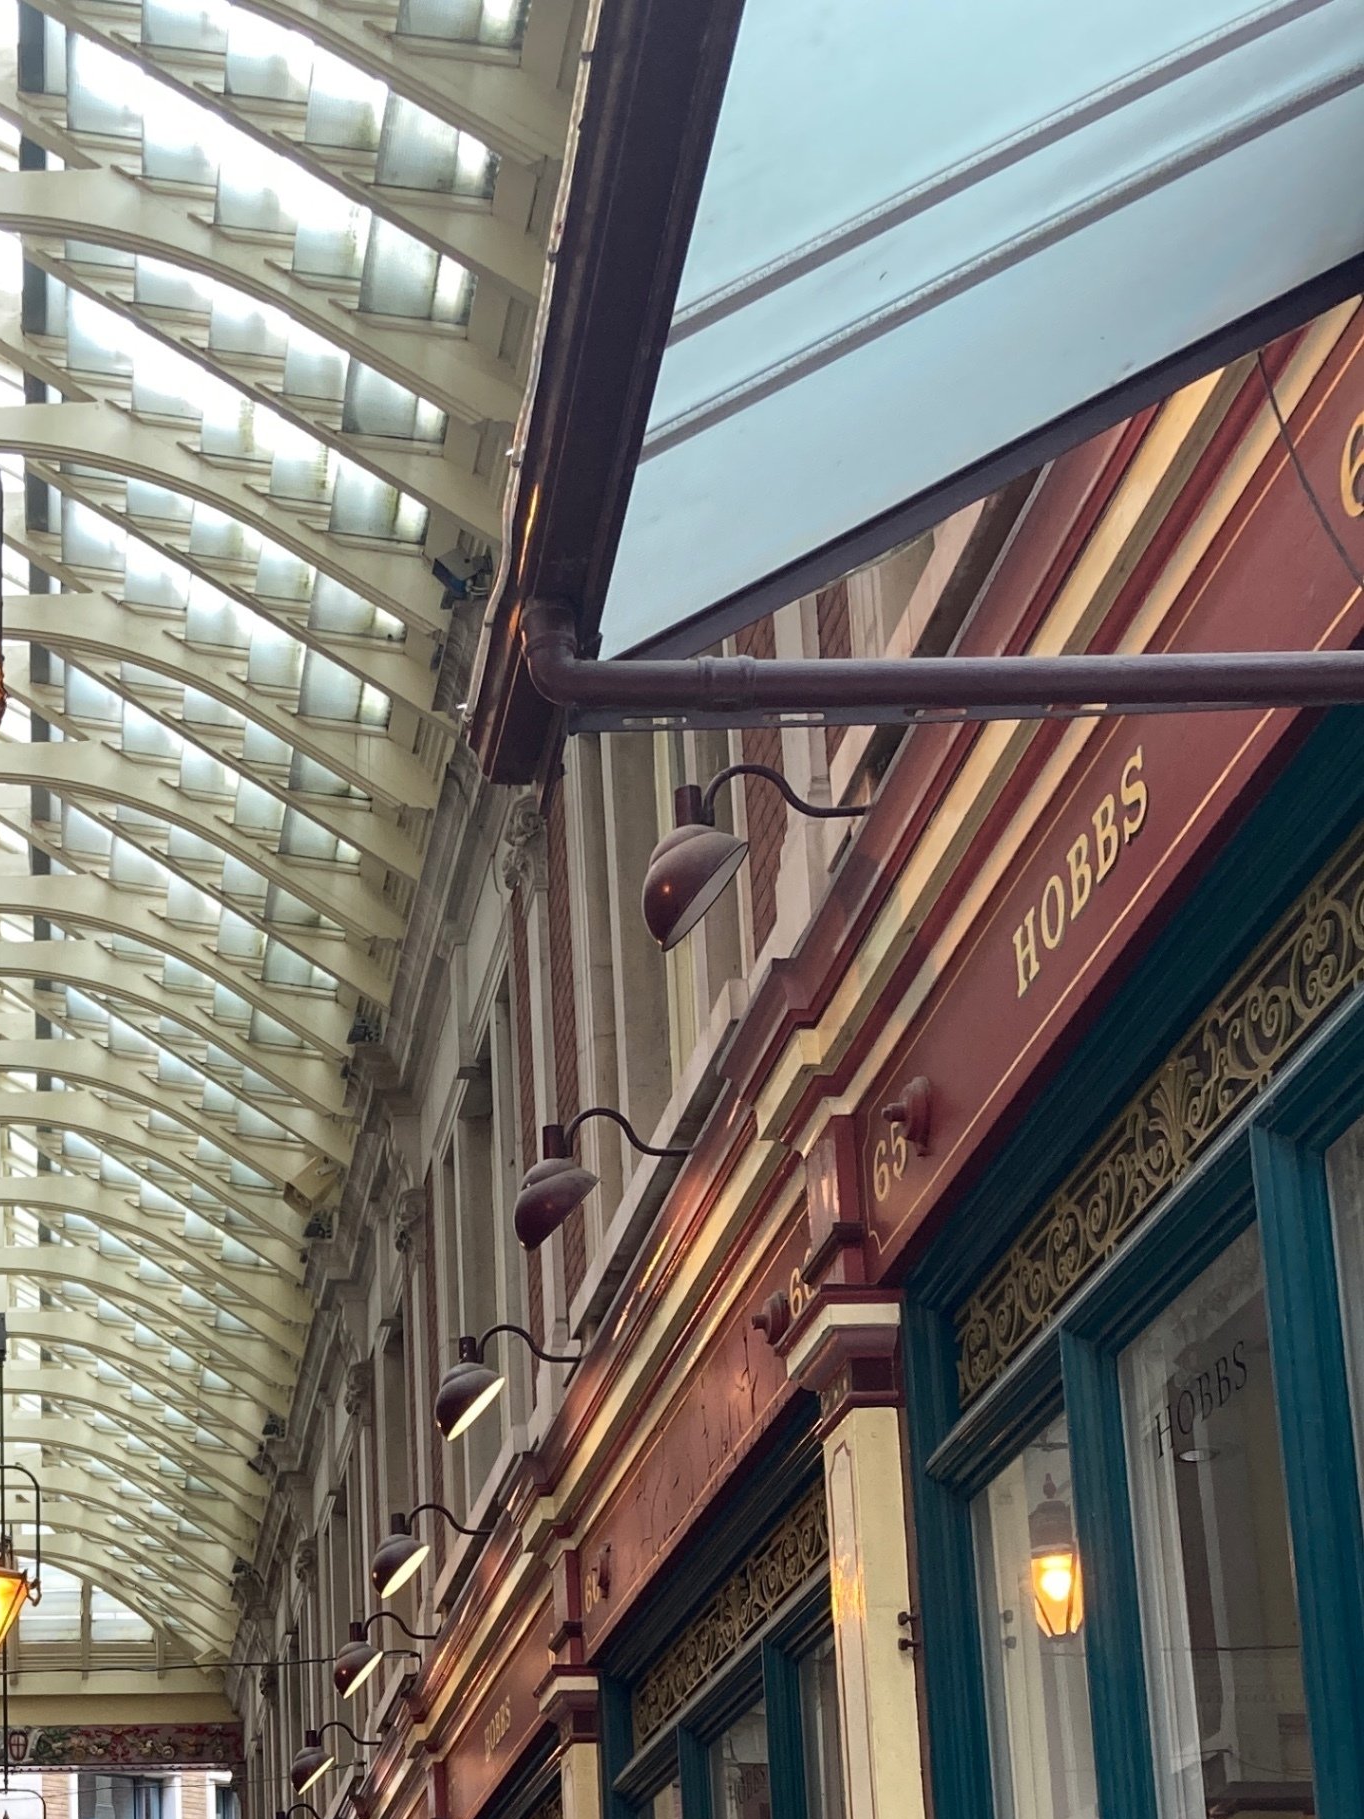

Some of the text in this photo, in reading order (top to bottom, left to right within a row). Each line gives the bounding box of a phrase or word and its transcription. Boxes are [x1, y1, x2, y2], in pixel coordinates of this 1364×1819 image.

[1012, 744, 1148, 999] HOBBS
[873, 1121, 907, 1202] 65
[1155, 1340, 1248, 1459] HOBBS
